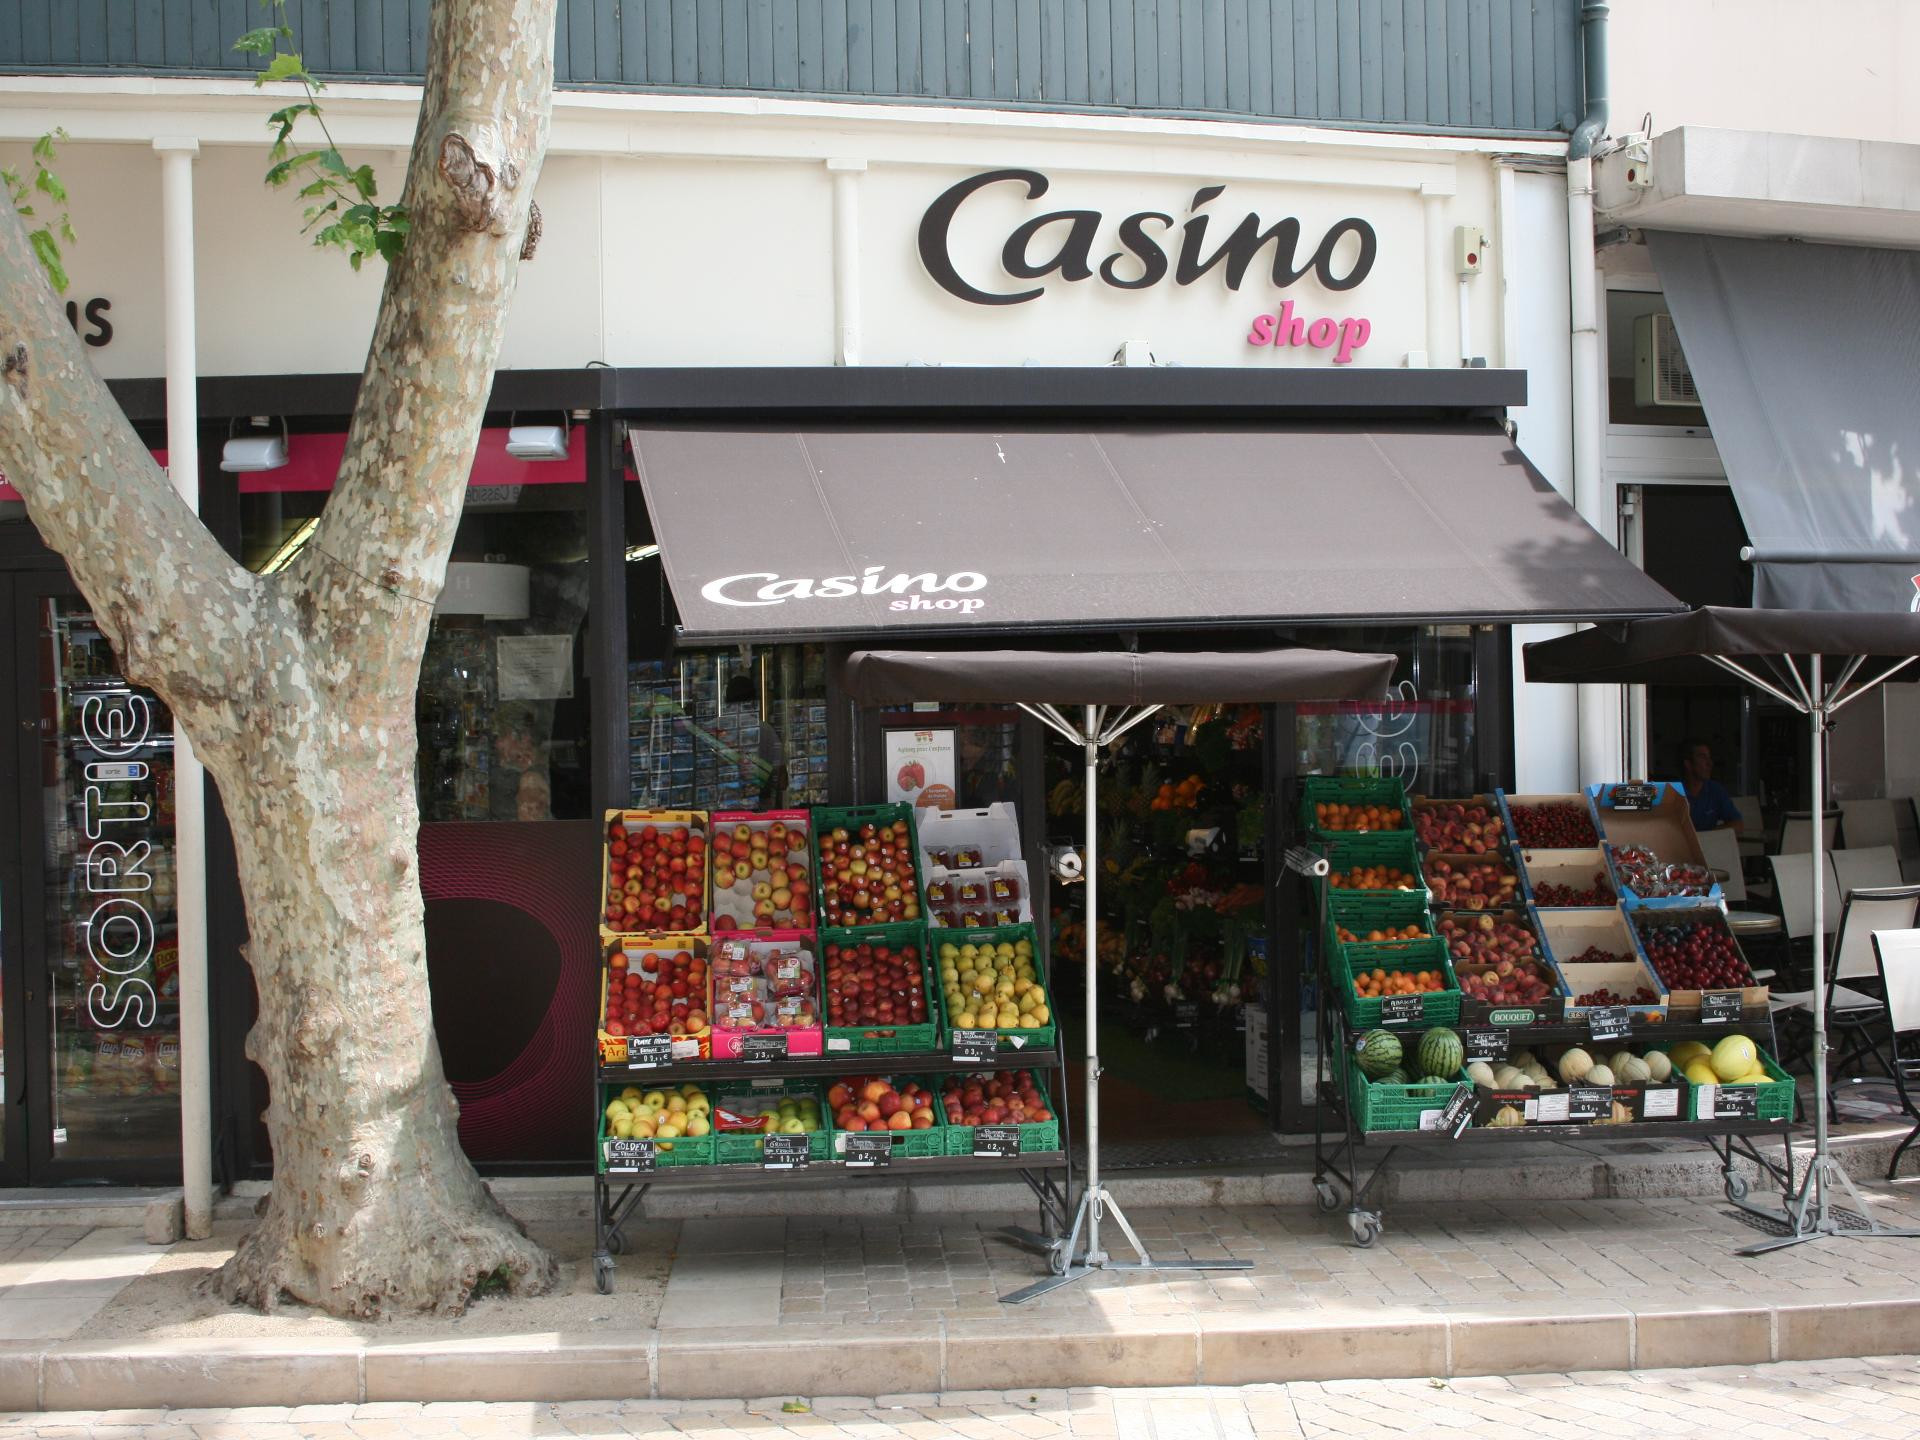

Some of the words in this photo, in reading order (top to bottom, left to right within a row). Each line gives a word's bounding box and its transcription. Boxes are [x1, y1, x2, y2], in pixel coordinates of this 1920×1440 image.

[918, 169, 1377, 306] Casino
[1247, 300, 1371, 363] shop
[701, 565, 988, 607] Casino
[888, 595, 985, 614] shop
[82, 695, 157, 1029] SORTIE
[1494, 1013, 1531, 1021] BOUQUET
[615, 1141, 648, 1151] GOLDEN
